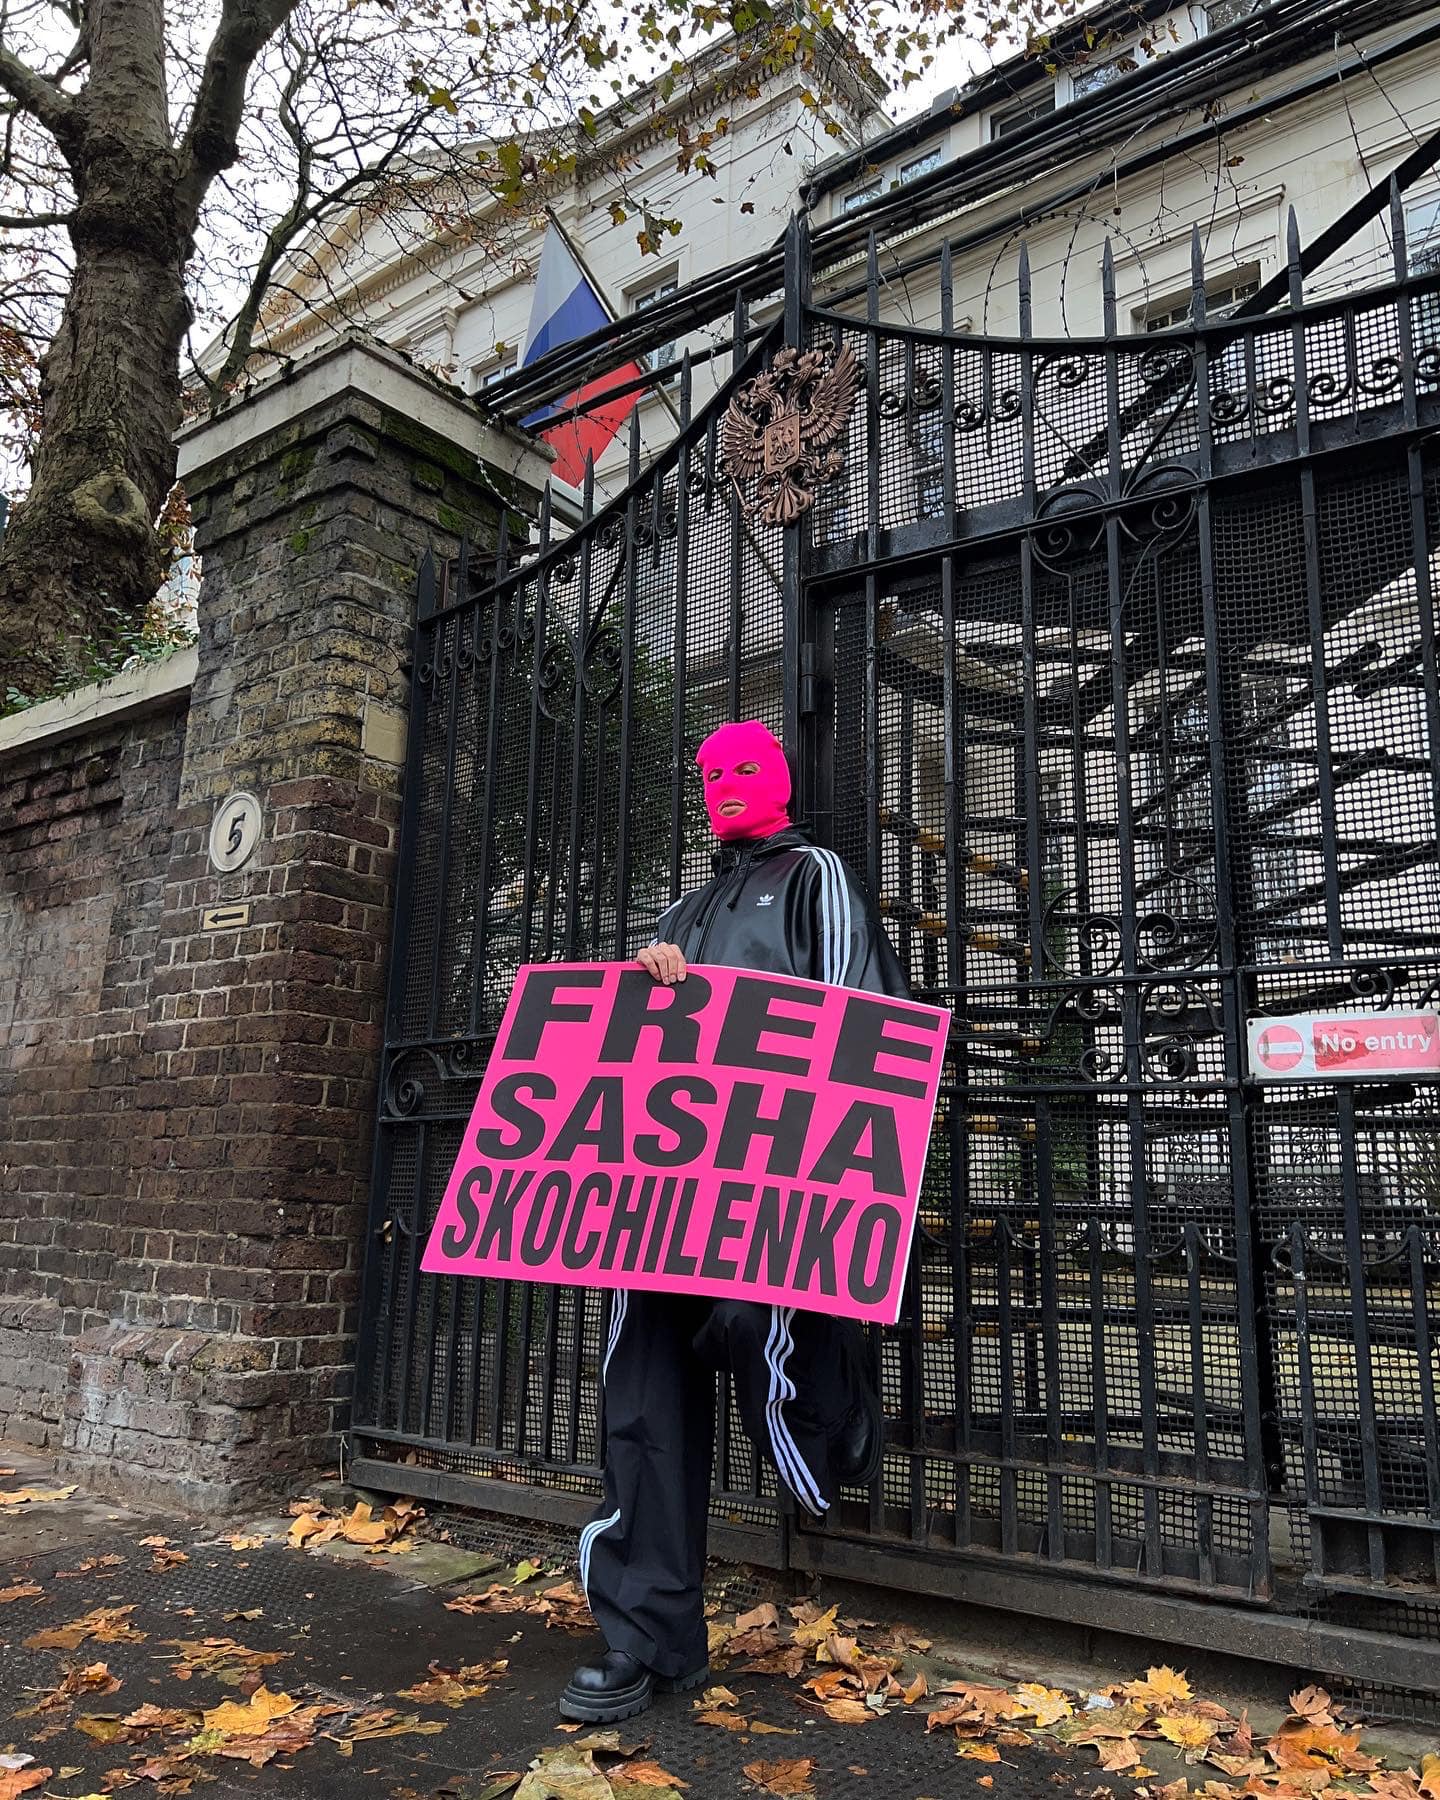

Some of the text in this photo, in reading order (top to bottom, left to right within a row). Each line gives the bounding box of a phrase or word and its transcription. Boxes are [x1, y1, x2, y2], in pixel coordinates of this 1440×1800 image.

[225, 812, 247, 856] 5
[501, 970, 941, 1100] FREE
[1321, 1031, 1432, 1053] No entry
[475, 1072, 907, 1198] SASHA
[440, 1165, 902, 1305] SKOCHILENKO
